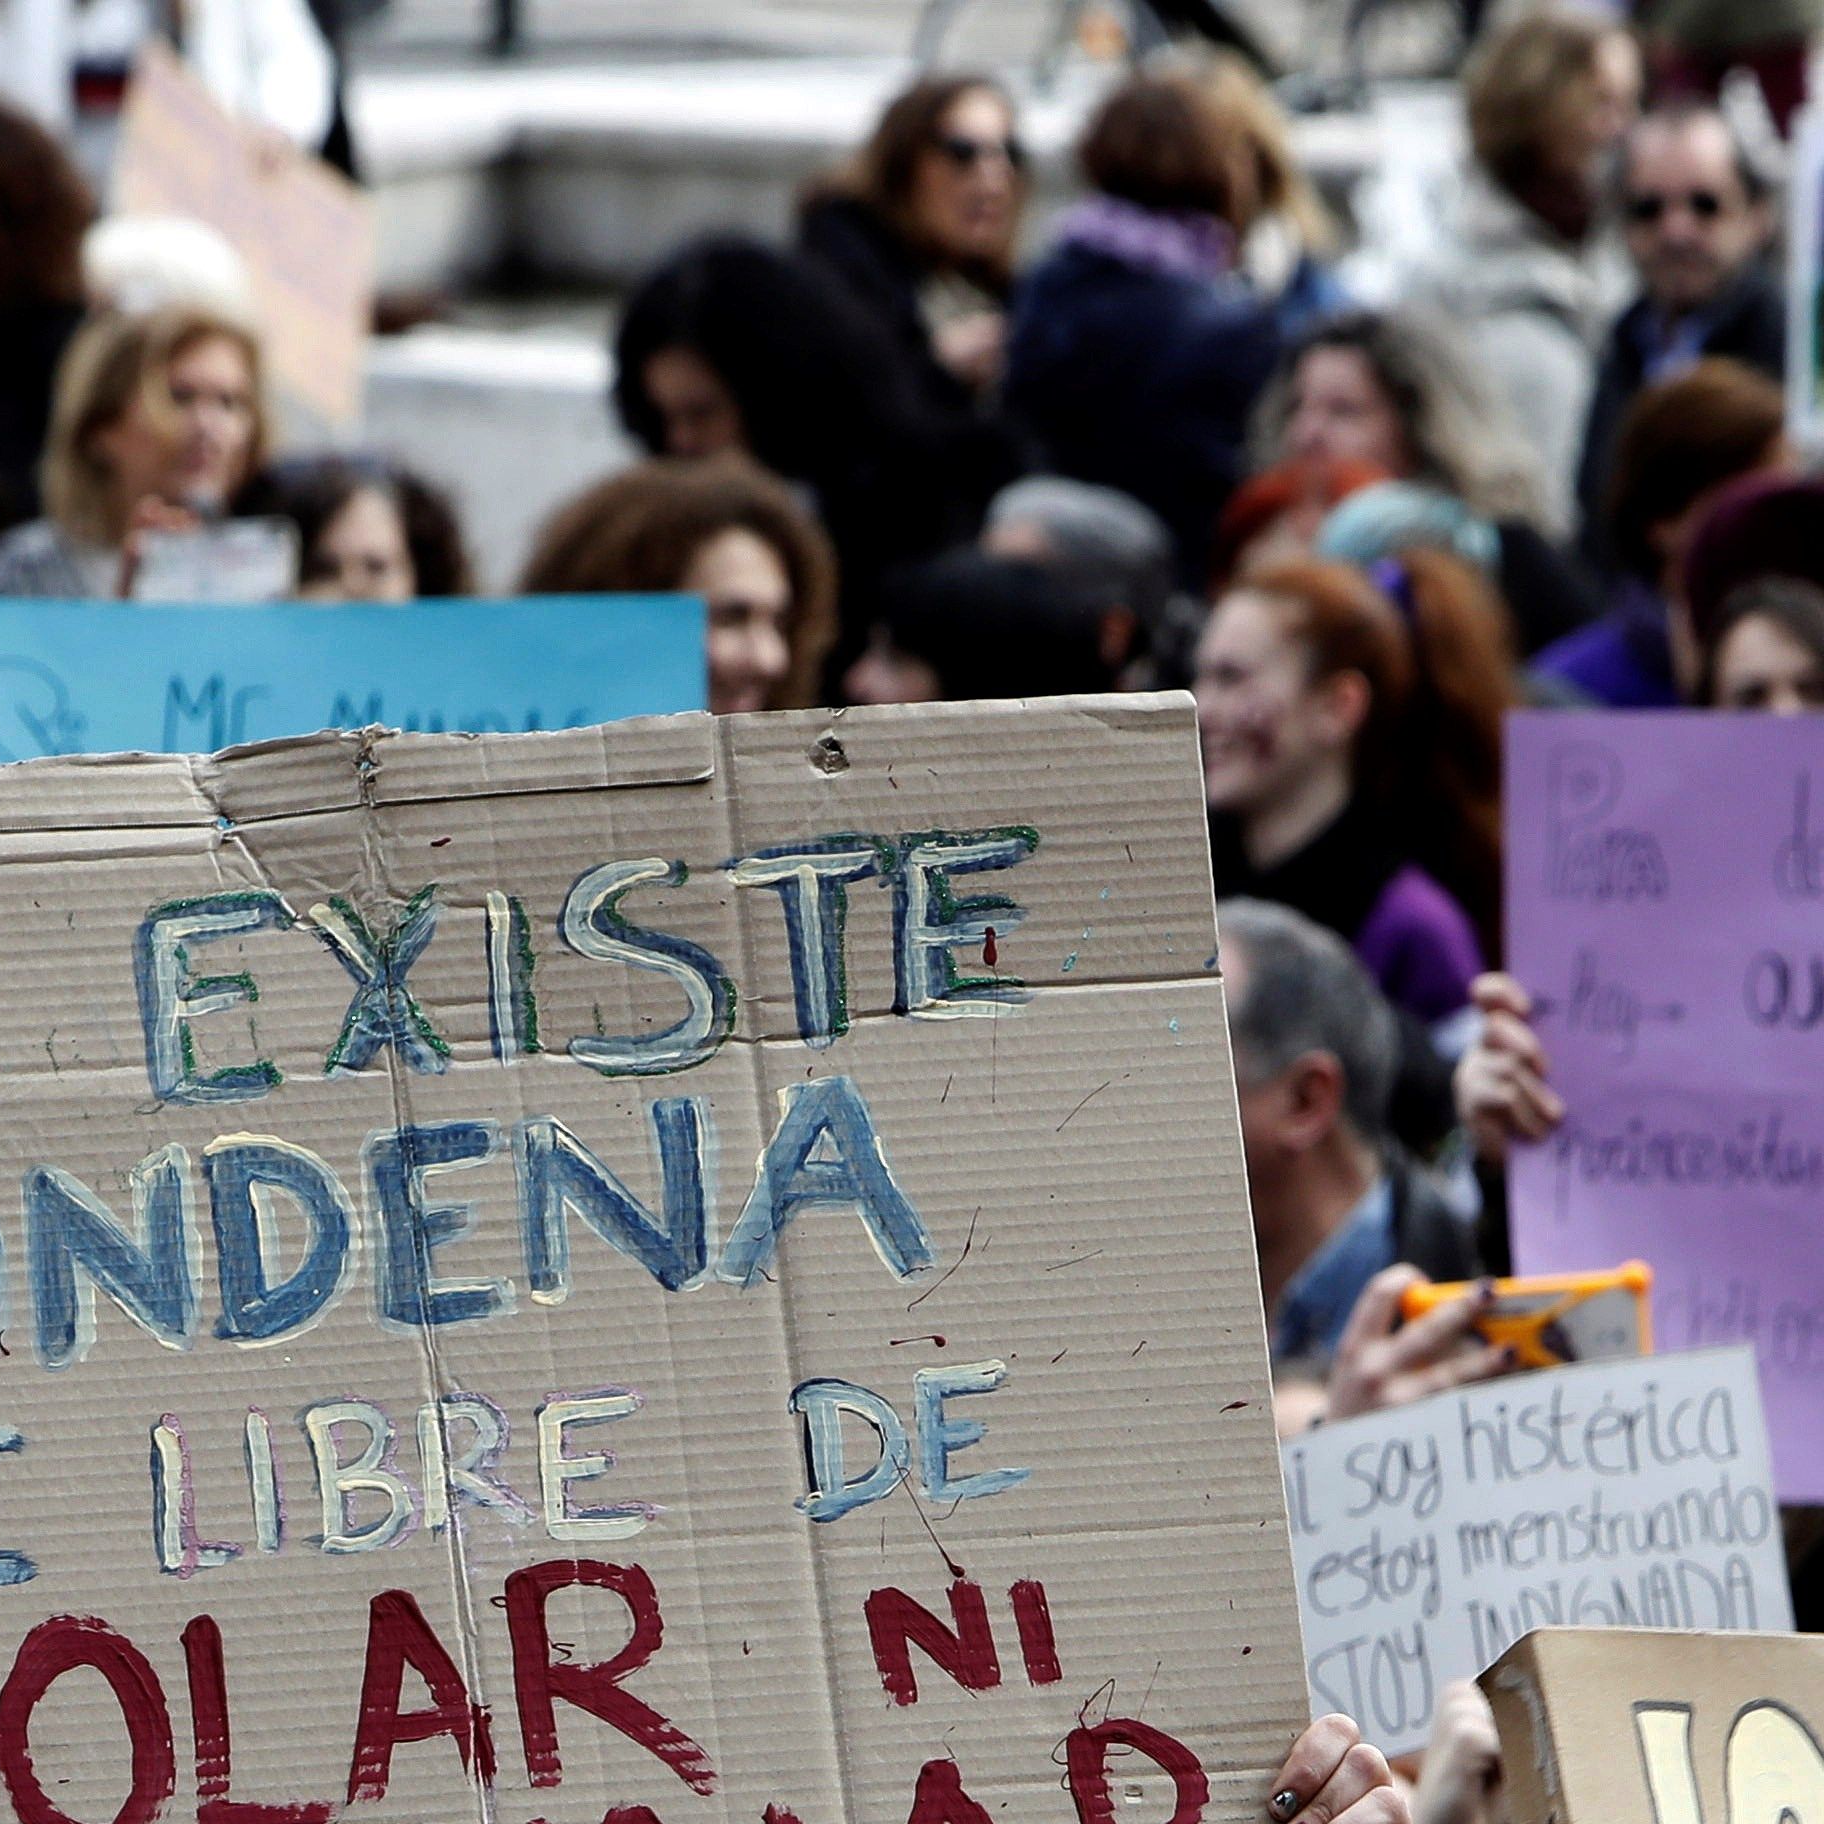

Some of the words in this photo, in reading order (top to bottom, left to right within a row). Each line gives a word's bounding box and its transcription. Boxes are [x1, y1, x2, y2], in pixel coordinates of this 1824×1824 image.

[132, 824, 1048, 1110] EXISTE
[152, 1390, 658, 1578] LIBRE
[786, 1356, 1031, 1524] DE
[1344, 1434, 1444, 1520] soy
[1457, 1381, 1743, 1484] histérica
[1306, 1526, 1444, 1620] estoy
[1456, 1474, 1774, 1576] menstruando
[860, 1576, 1064, 1708] NI
